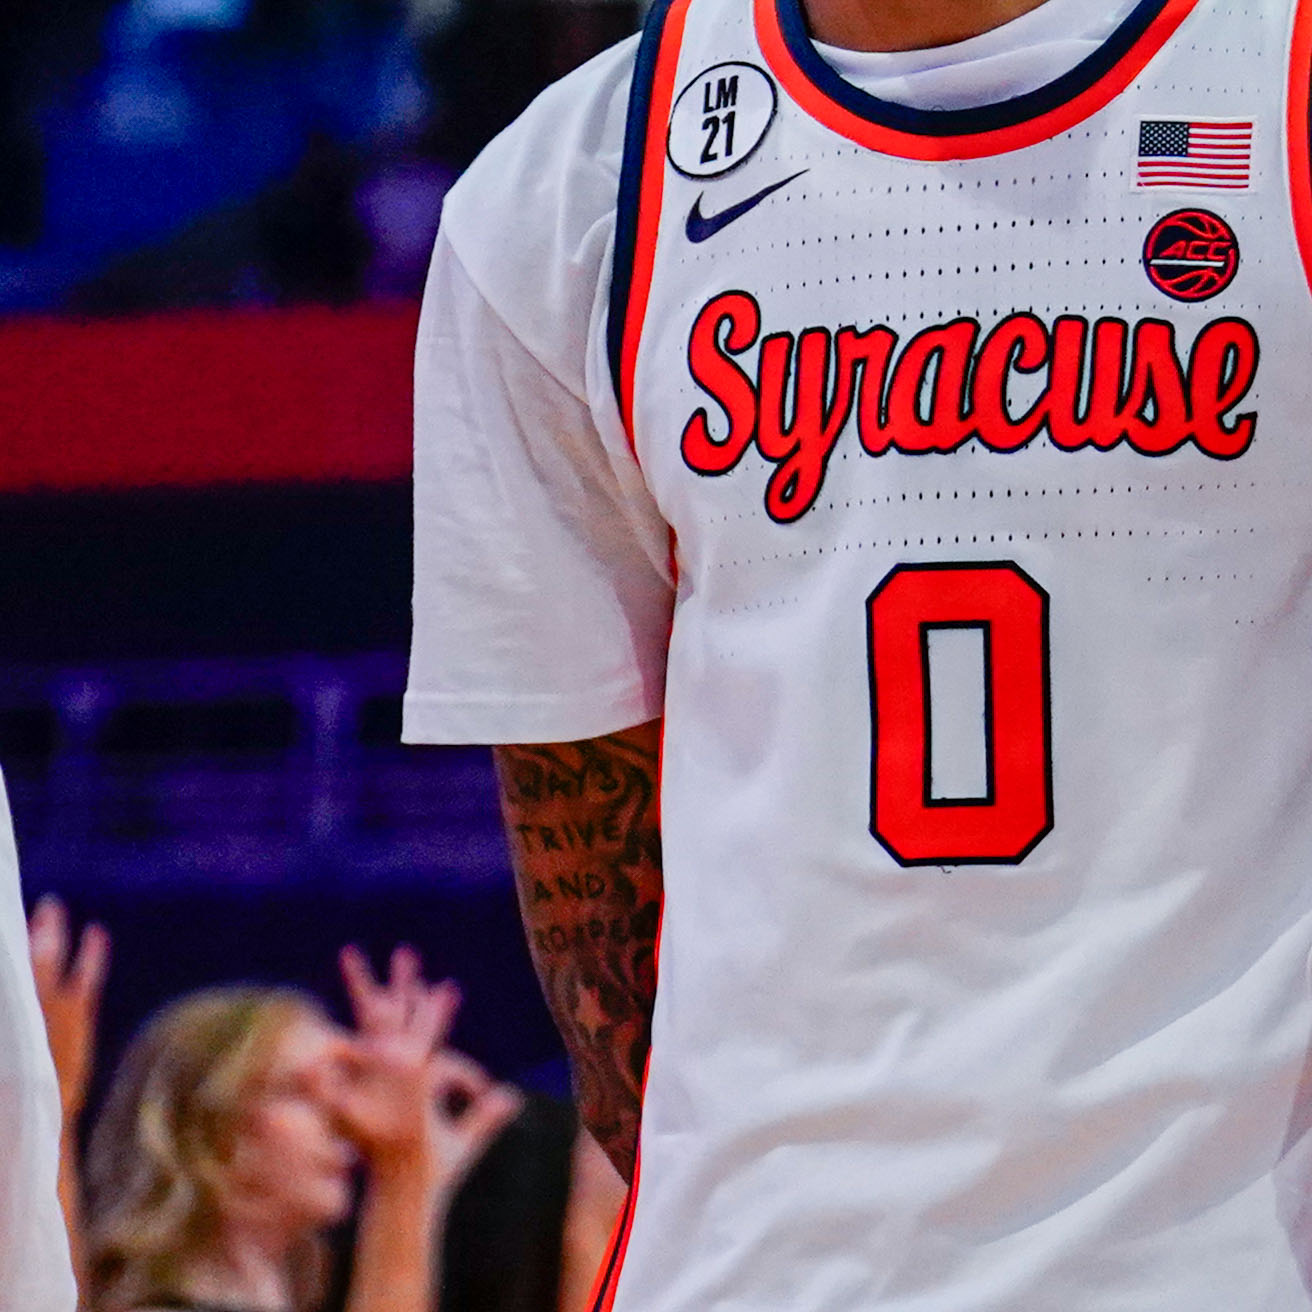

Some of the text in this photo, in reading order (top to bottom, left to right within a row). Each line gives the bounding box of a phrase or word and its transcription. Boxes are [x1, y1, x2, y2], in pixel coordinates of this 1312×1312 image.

[703, 75, 739, 114] LM
[700, 110, 736, 165] 21
[1159, 239, 1233, 261] ACC
[681, 290, 1260, 524] Syracuse
[865, 560, 1054, 867] 0
[533, 870, 606, 902] AND
